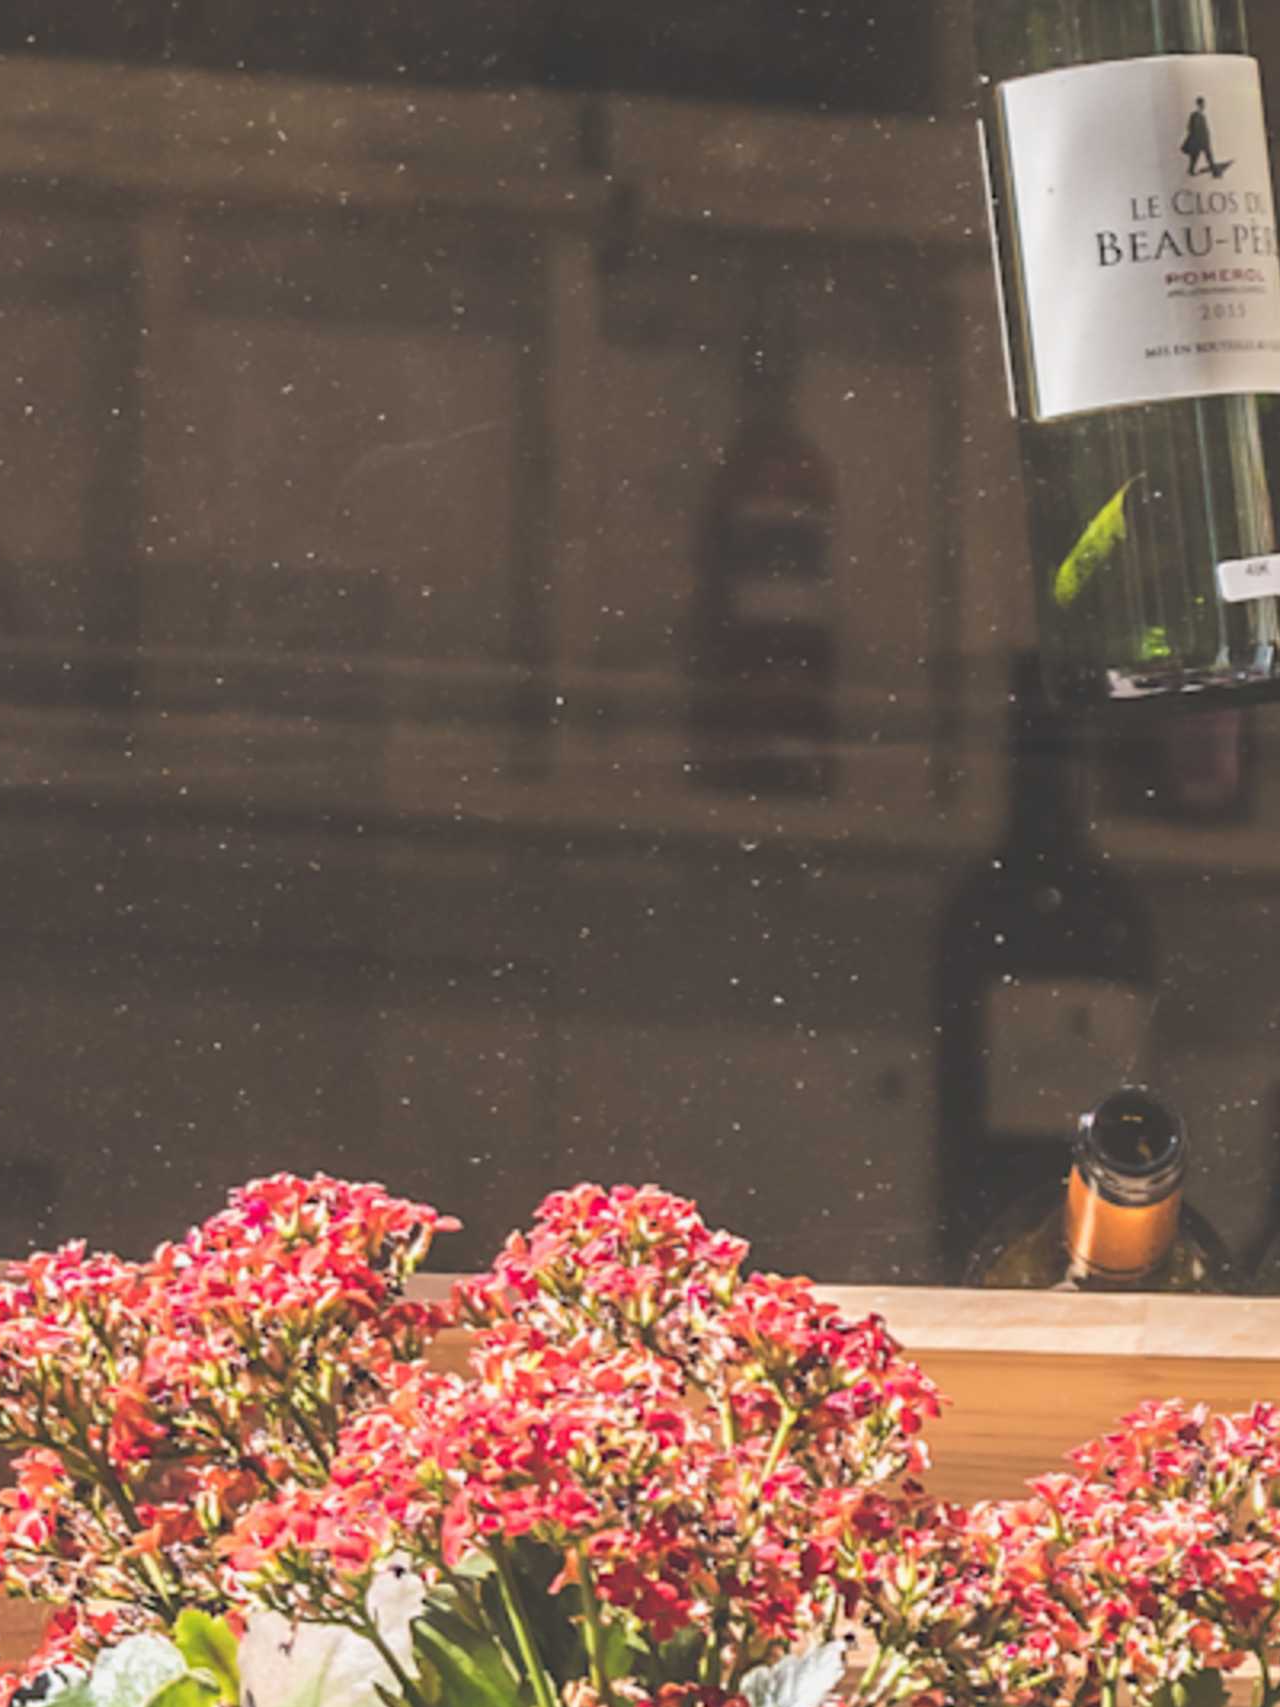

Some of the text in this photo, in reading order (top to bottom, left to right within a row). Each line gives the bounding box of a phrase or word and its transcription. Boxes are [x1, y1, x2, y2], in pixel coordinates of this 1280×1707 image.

[1130, 195, 1161, 221] LE
[1172, 189, 1239, 216] CLOS
[1165, 268, 1265, 285] POMEROL
